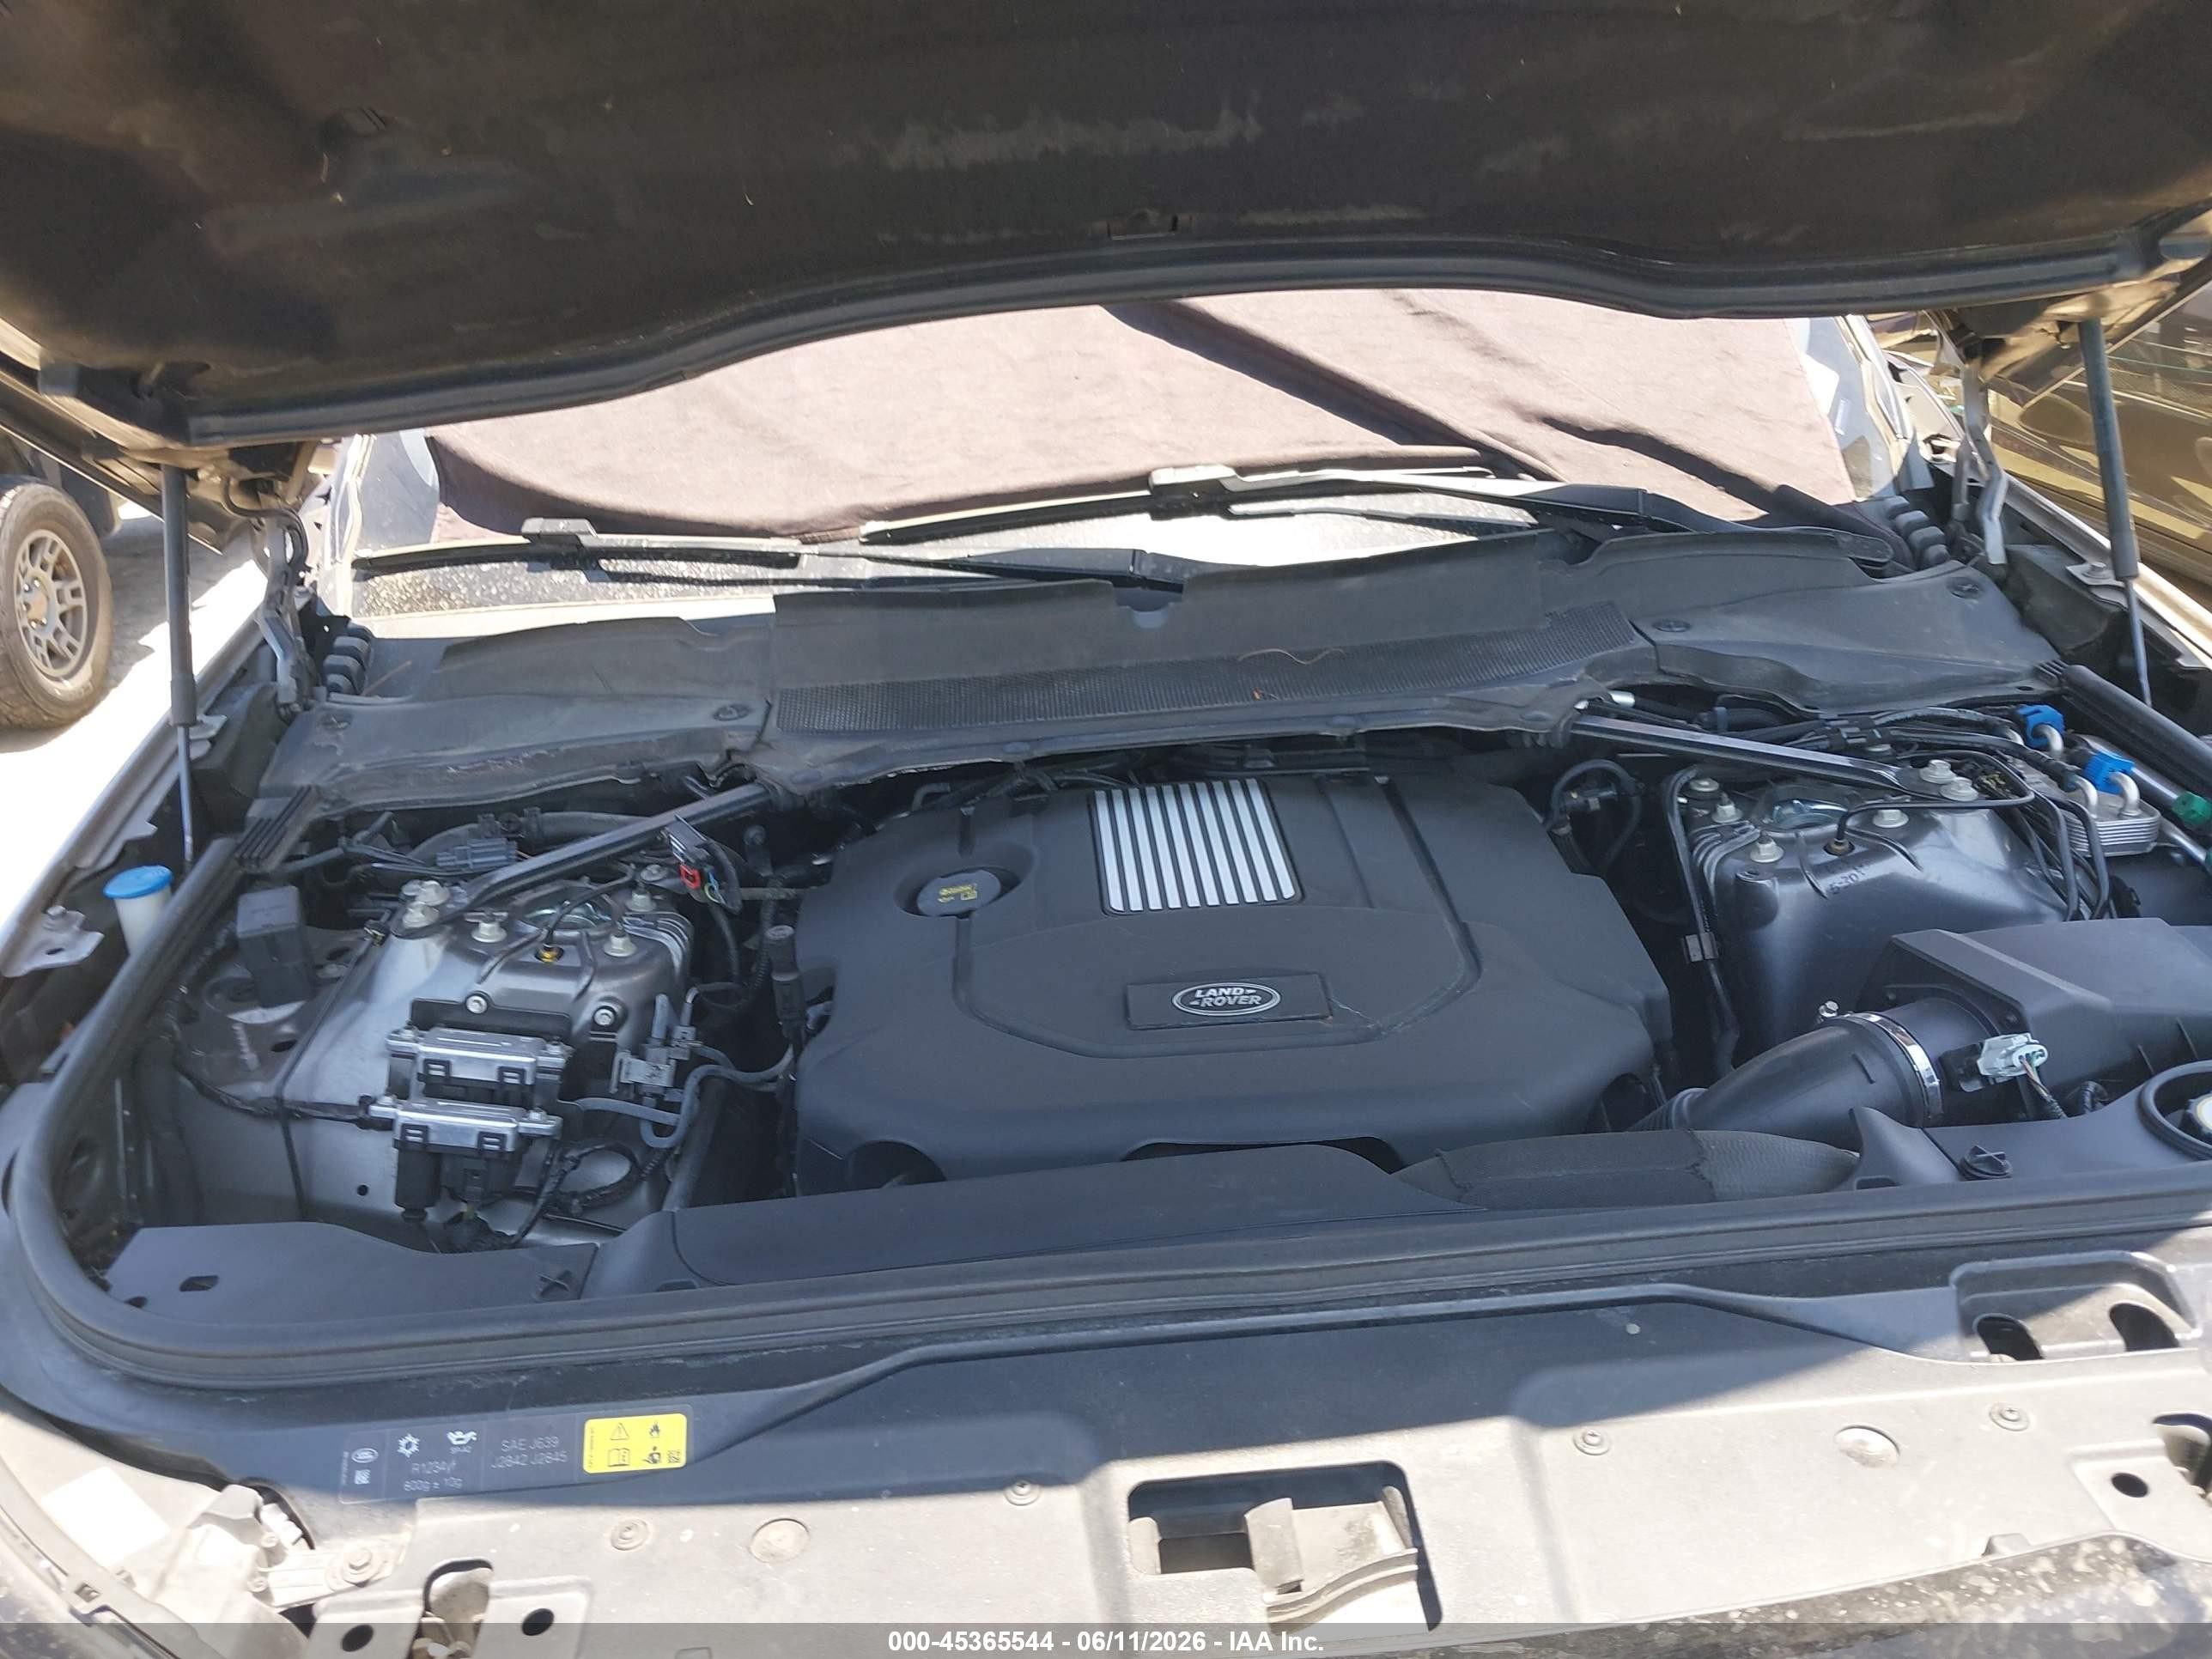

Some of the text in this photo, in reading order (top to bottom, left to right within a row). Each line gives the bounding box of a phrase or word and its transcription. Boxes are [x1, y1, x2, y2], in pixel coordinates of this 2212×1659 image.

[1194, 987, 1245, 998] LAND
[1200, 994, 1262, 1007] ROVER
[501, 1435, 559, 1453] SAE J639
